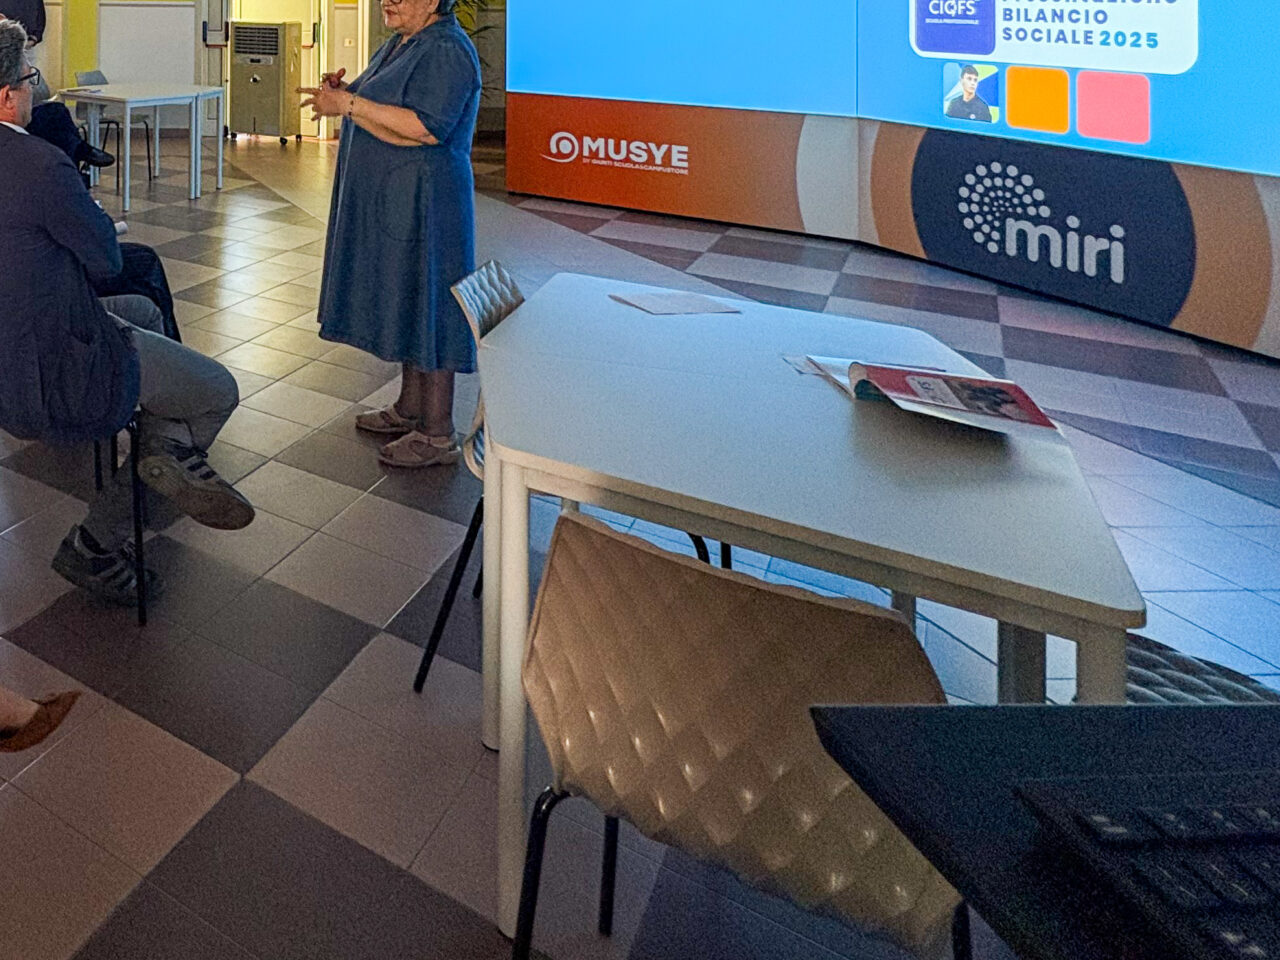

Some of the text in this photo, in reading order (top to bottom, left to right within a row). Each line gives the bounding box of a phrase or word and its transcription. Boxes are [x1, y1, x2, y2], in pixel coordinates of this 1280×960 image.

[1002, 7, 1108, 25] BILANCIO
[1002, 27, 1159, 49] SOCIALE 2025
[582, 136, 688, 168] MUSYE
[1005, 215, 1125, 284] miri
